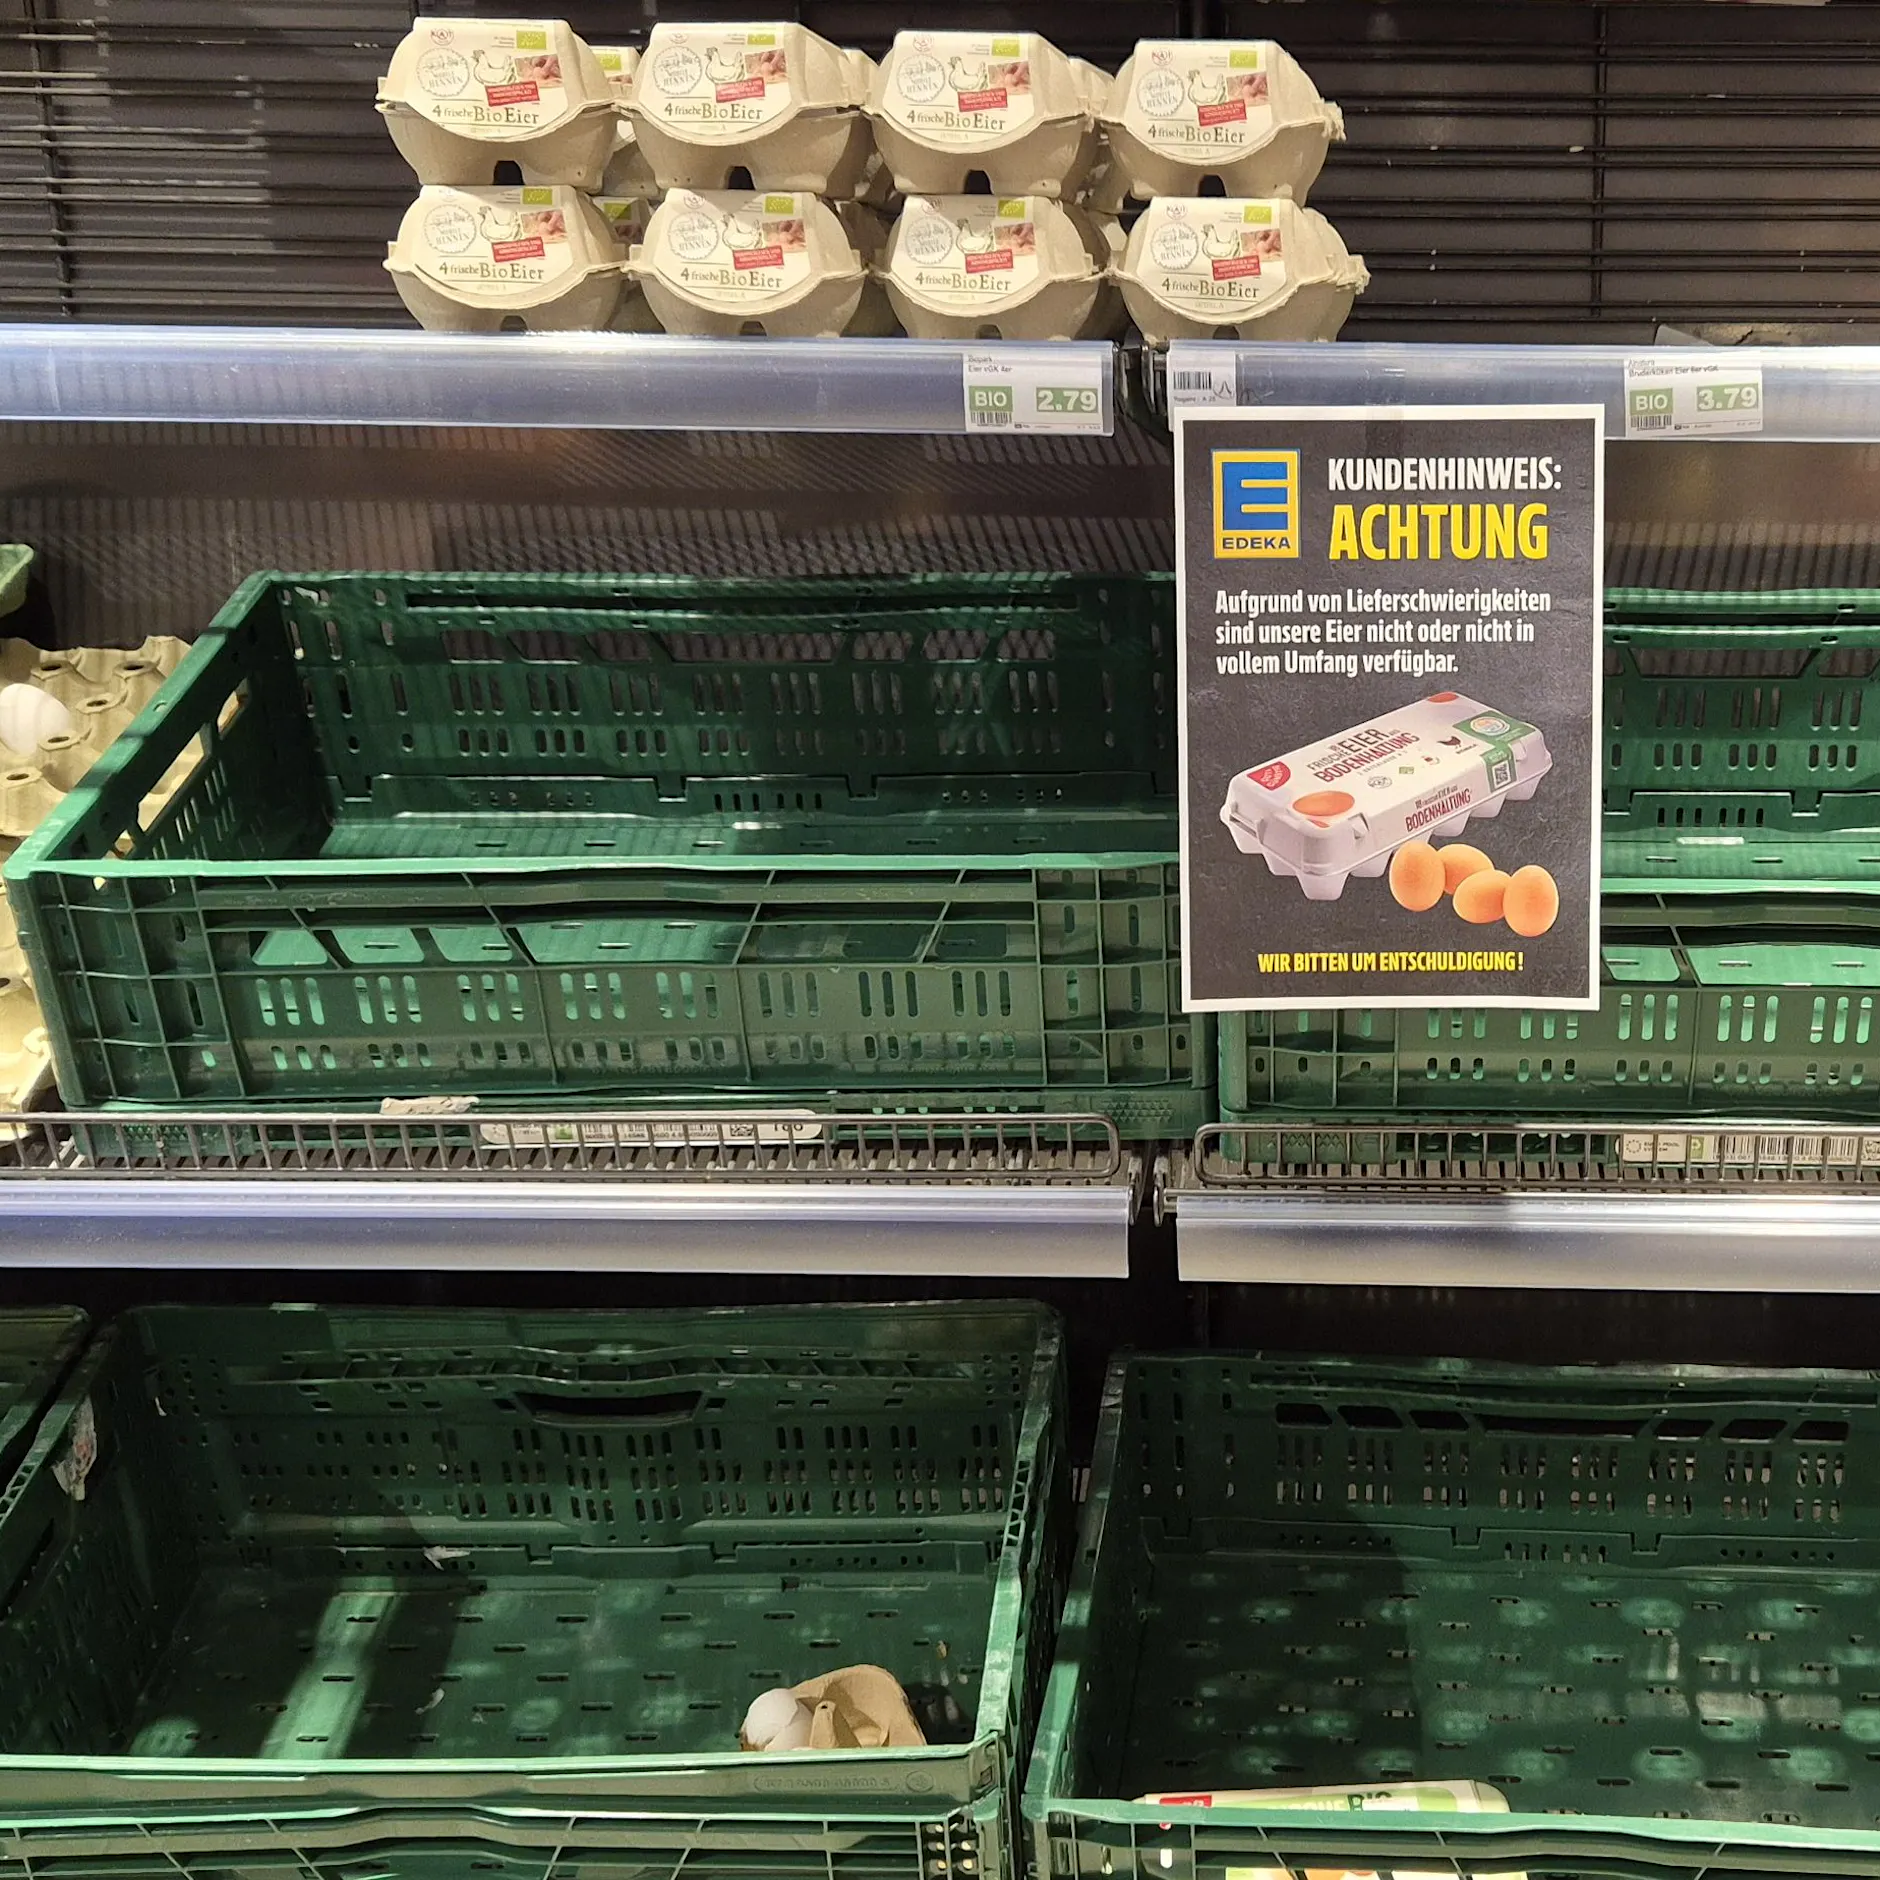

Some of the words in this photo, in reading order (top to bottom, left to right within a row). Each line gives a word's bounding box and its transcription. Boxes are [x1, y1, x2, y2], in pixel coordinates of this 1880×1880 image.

[432, 105, 442, 117] 4
[444, 107, 474, 118] frische
[664, 103, 673, 116] 4
[675, 105, 702, 115] frische
[907, 111, 915, 123] 4
[917, 111, 944, 124] frische
[1148, 125, 1157, 138] 4
[1158, 127, 1185, 138] frische
[439, 262, 448, 275] 4
[450, 264, 480, 275] frische
[680, 268, 690, 281] 4
[691, 270, 719, 281] frische
[915, 272, 924, 284] 4
[925, 274, 952, 285] frische
[1162, 278, 1171, 291] 4
[1172, 280, 1199, 291] frische
[974, 392, 1006, 407] BIO
[1037, 390, 1097, 411] 2.79
[1636, 395, 1668, 411] BIO
[1699, 387, 1757, 410] 3.79
[1328, 456, 1562, 491] KUNDENHINWEIS:
[1329, 503, 1549, 560] ACHTUNG
[1222, 538, 1291, 550] EDEKA
[1216, 589, 1303, 618] Aufgrund
[1309, 595, 1342, 613] von
[1347, 589, 1551, 616] Lieferschwierigkeiten
[1216, 621, 1254, 645] sind
[1259, 625, 1321, 643] unsere
[1326, 622, 1361, 643] Eier
[1367, 621, 1413, 643] nicht
[1417, 620, 1461, 643] oder
[1466, 620, 1511, 643] nicht
[1516, 620, 1534, 642] in
[1216, 652, 1281, 675] vollem
[1285, 651, 1357, 677] Umfang
[1362, 649, 1459, 675] verfügbar.
[1338, 729, 1390, 753] EIER
[1313, 733, 1420, 782] BODENHALTUNG
[1406, 789, 1470, 832] BODENHALTUNG
[1258, 953, 1291, 972] WIR
[1294, 953, 1348, 972] BITTEN
[1352, 953, 1376, 972] UM
